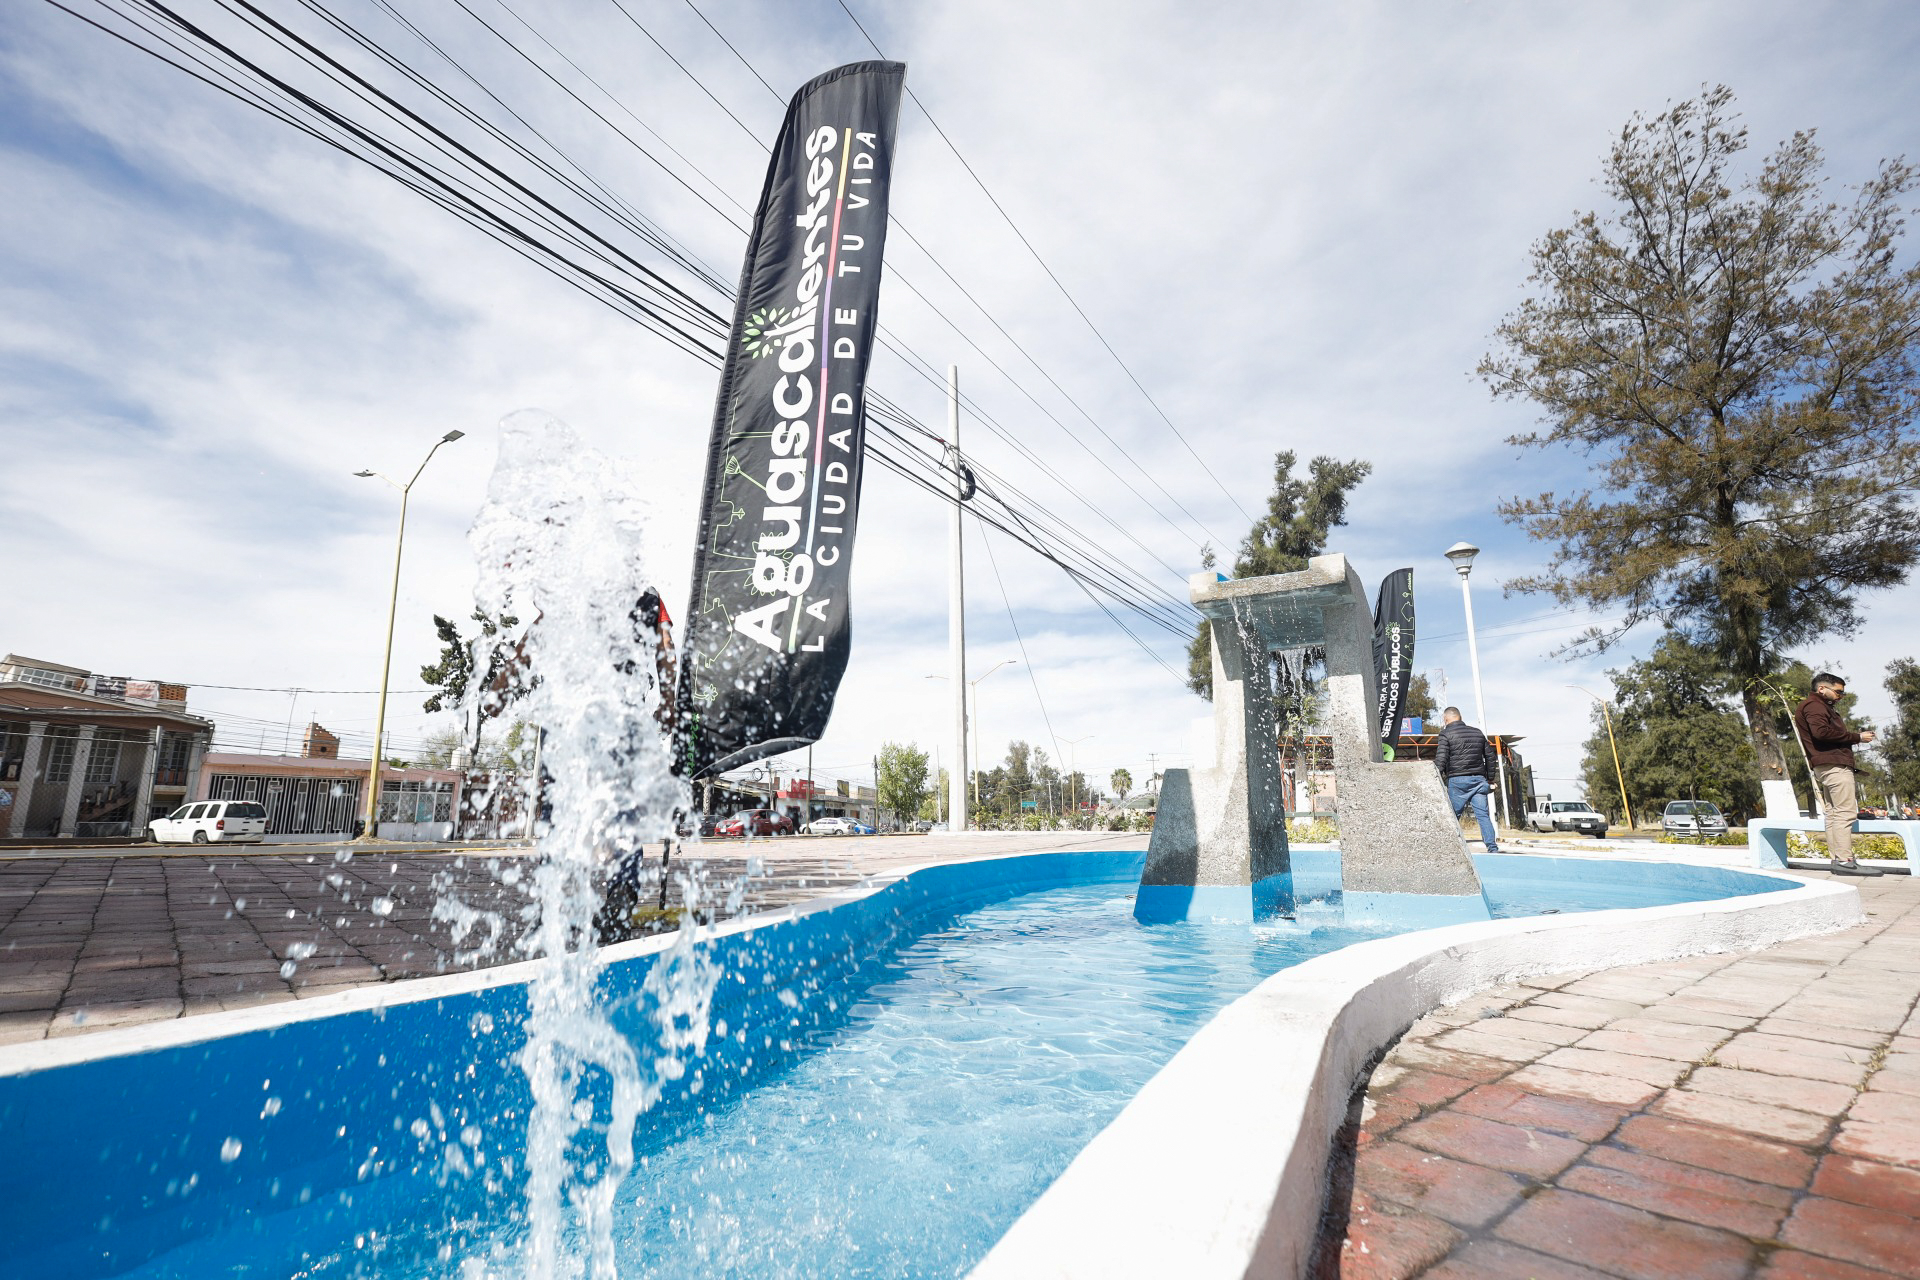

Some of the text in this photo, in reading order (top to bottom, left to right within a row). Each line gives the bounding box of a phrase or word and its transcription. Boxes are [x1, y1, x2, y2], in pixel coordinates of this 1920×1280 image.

[734, 125, 838, 653] Aguascalientes
[802, 131, 876, 652] LA CIUDAD DE TU VIDA
[1380, 626, 1401, 738] SERVICIOS PÚBLICOS
[1381, 672, 1389, 684] DE
